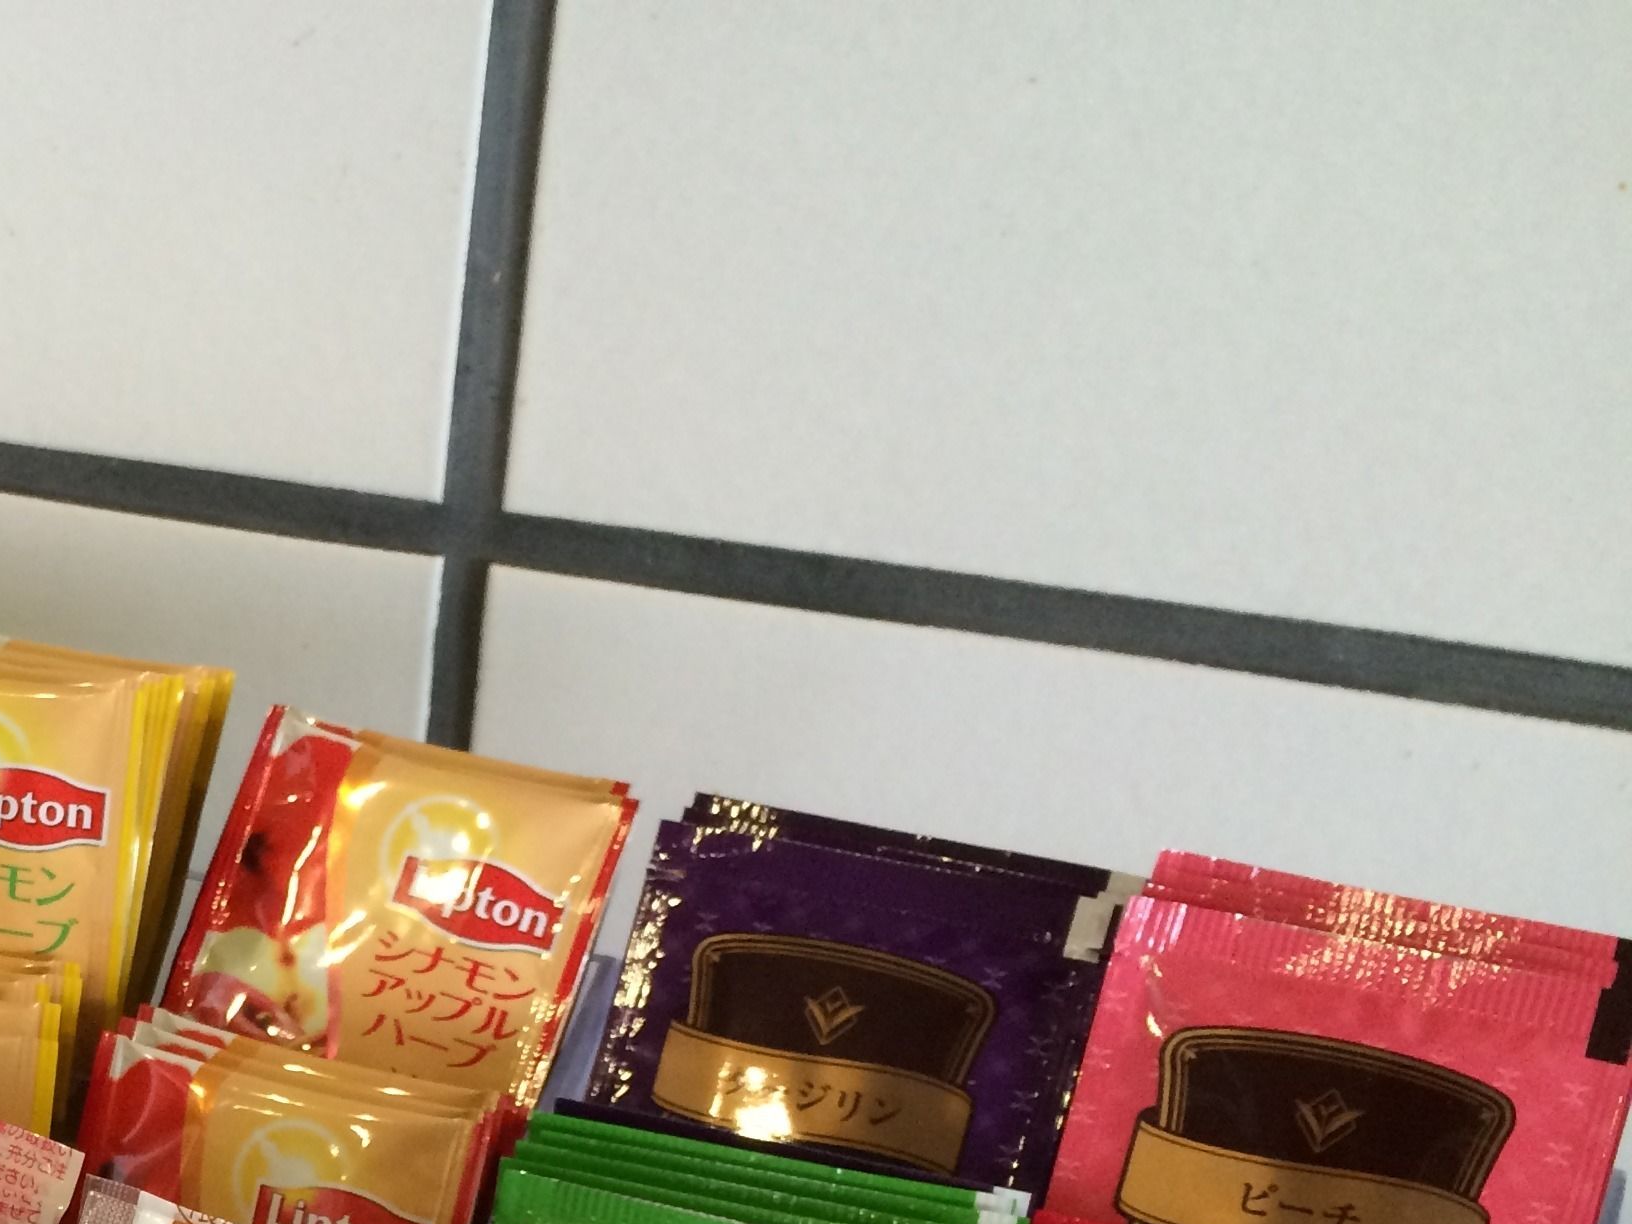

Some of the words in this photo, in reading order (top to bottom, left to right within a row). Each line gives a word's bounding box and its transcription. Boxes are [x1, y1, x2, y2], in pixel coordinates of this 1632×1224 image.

[374, 931, 536, 1000] シナモン
[361, 969, 520, 1040] アップル
[361, 1014, 497, 1068] ハーブ
